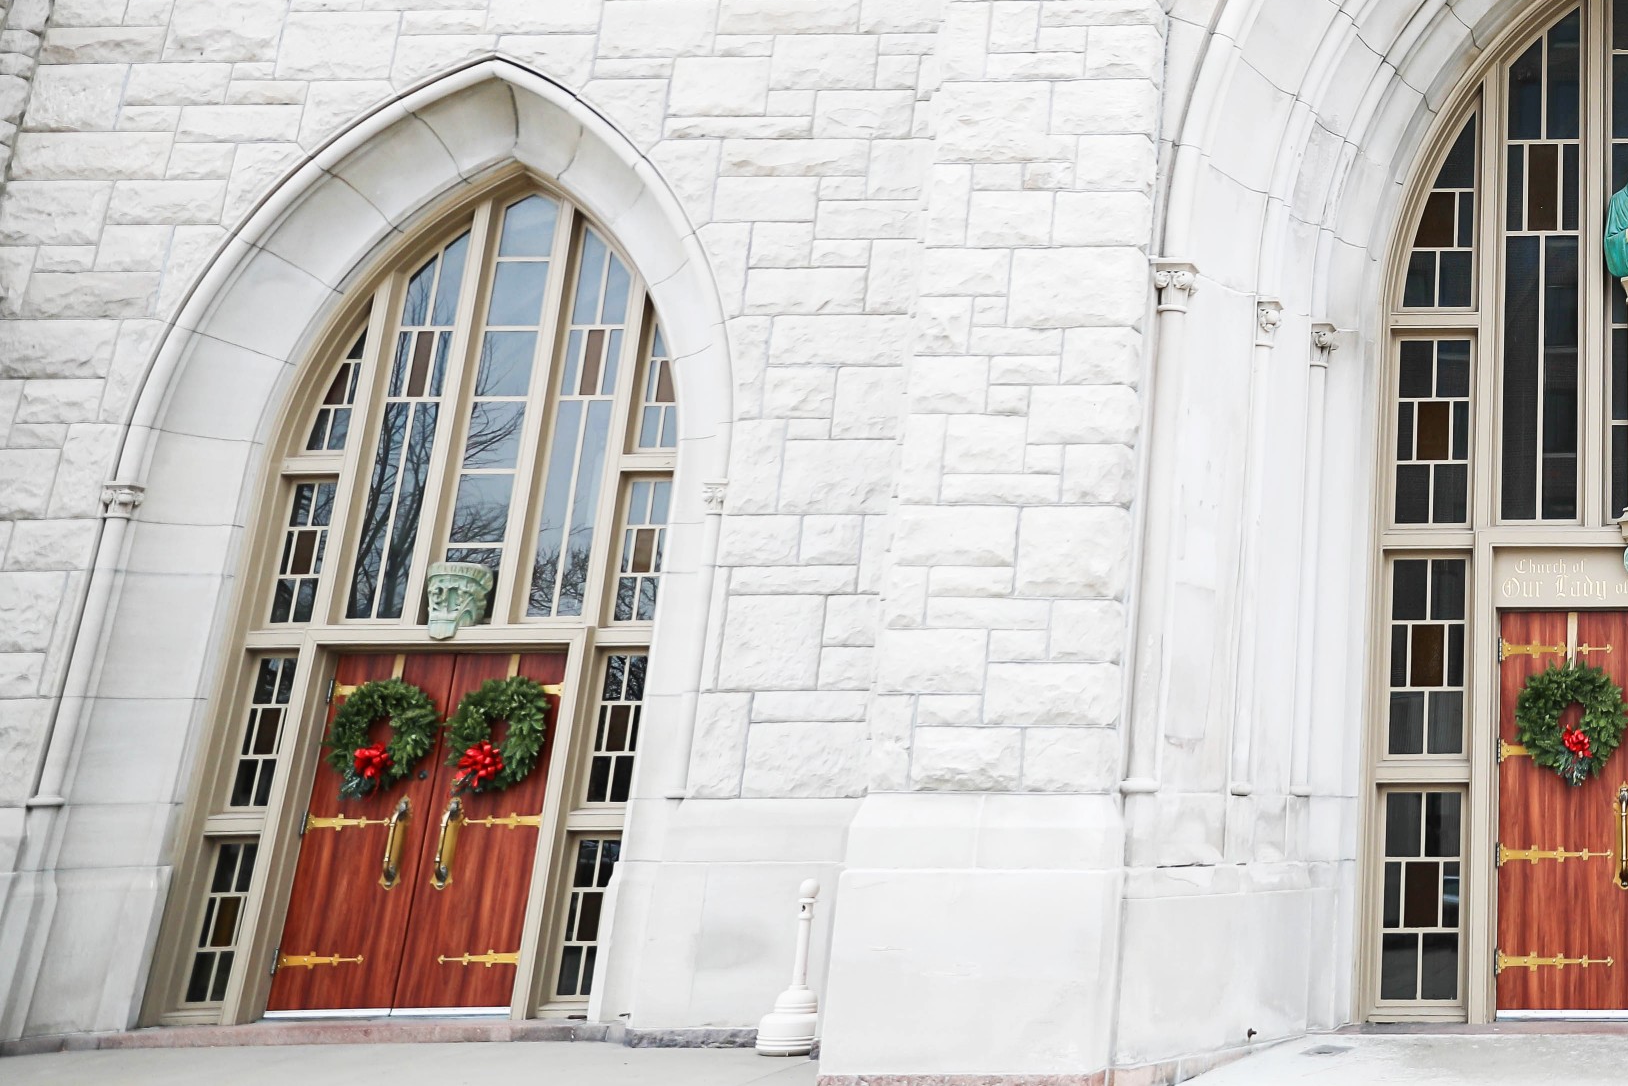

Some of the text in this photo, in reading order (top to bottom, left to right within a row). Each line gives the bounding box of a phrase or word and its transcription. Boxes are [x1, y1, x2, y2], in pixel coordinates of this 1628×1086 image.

[1514, 558, 1587, 574] Church of
[1502, 577, 1543, 598] Our
[1555, 574, 1608, 600] Lady
